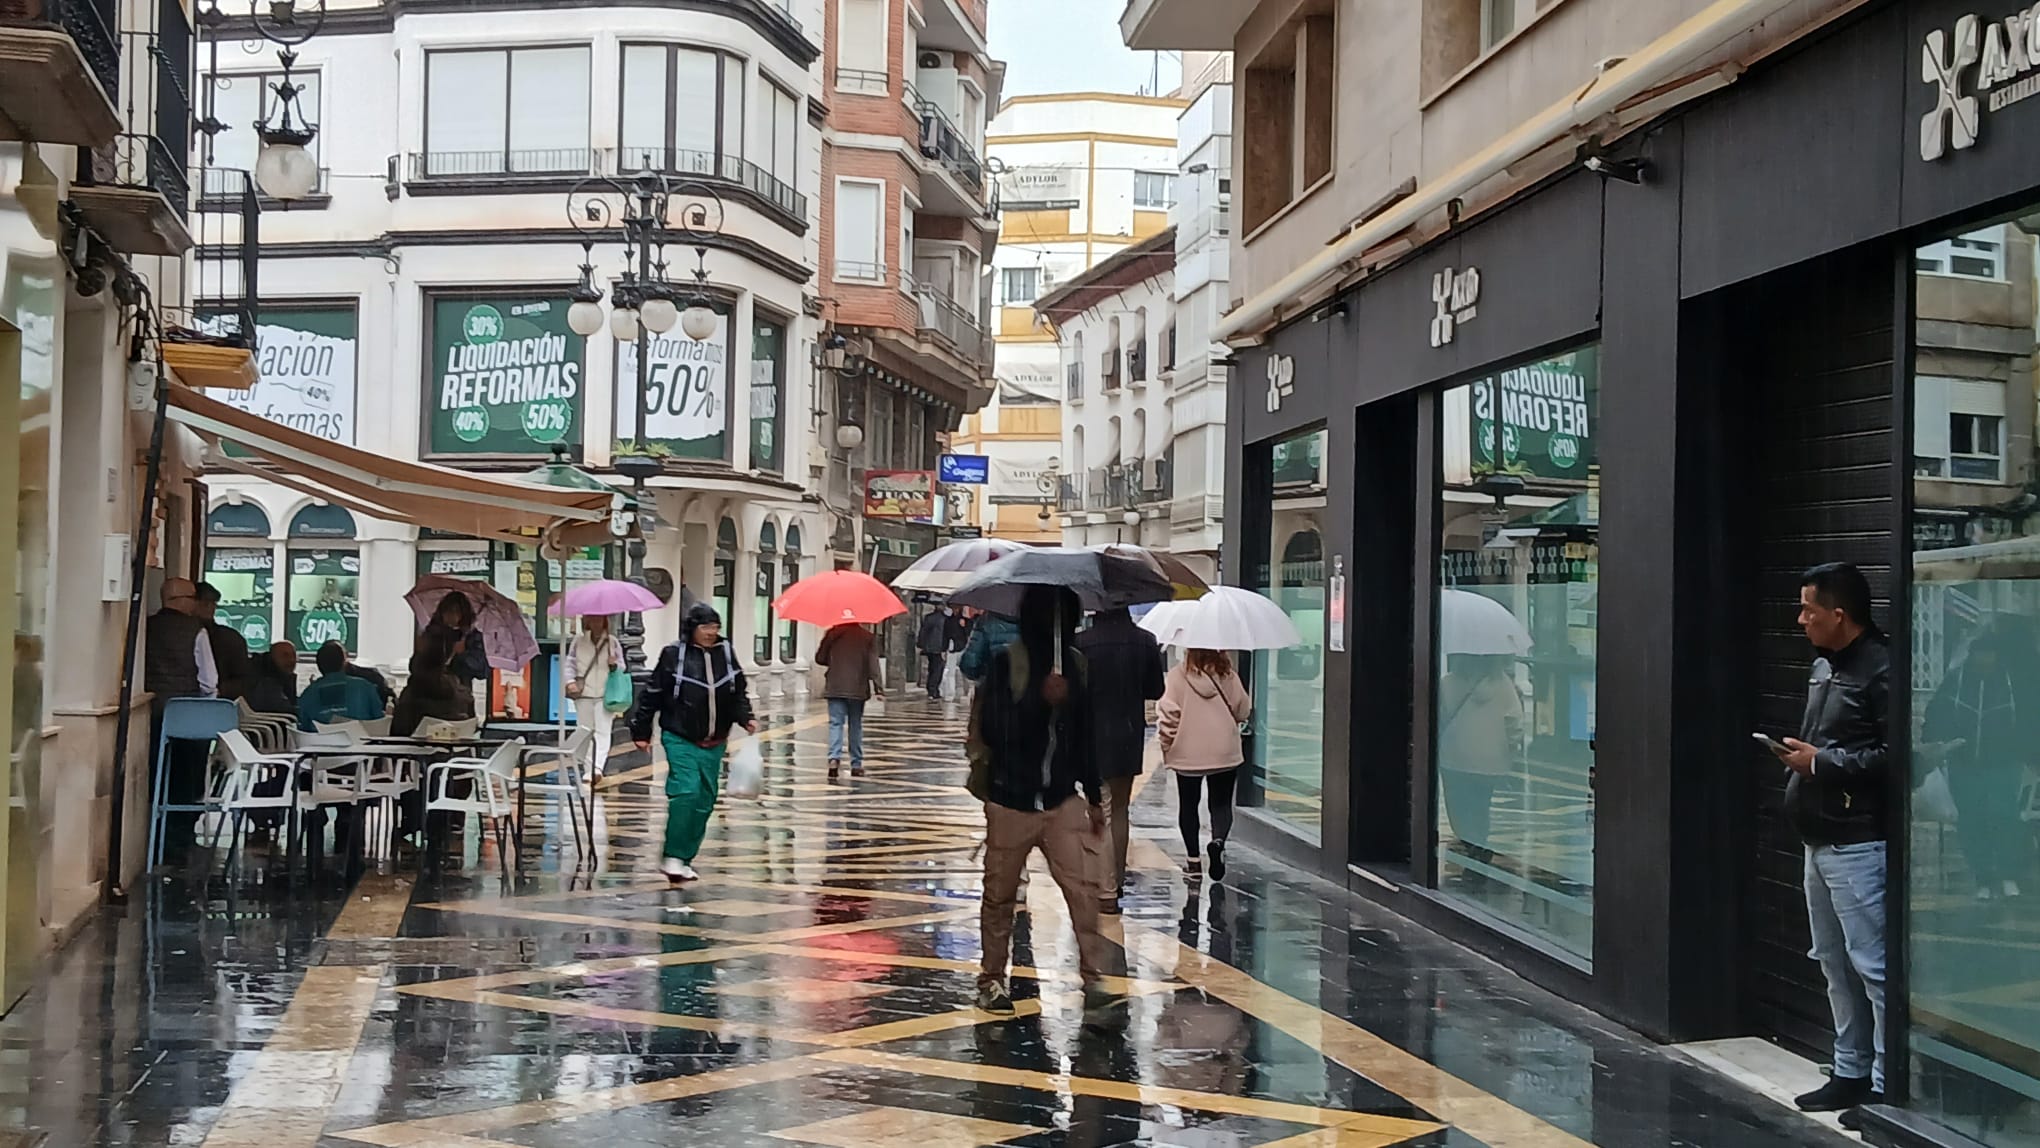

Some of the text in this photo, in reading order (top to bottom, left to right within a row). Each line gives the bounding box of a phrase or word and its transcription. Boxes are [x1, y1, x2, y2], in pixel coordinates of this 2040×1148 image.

[469, 316, 497, 337] 30%
[447, 331, 566, 374] LIQUIDACIÓN
[440, 362, 579, 411] REFORMAS
[645, 363, 715, 418] 50%
[455, 411, 485, 432] 40%
[526, 403, 566, 431] 50%
[212, 555, 273, 571] REFORMAS
[305, 618, 342, 644] 50%
